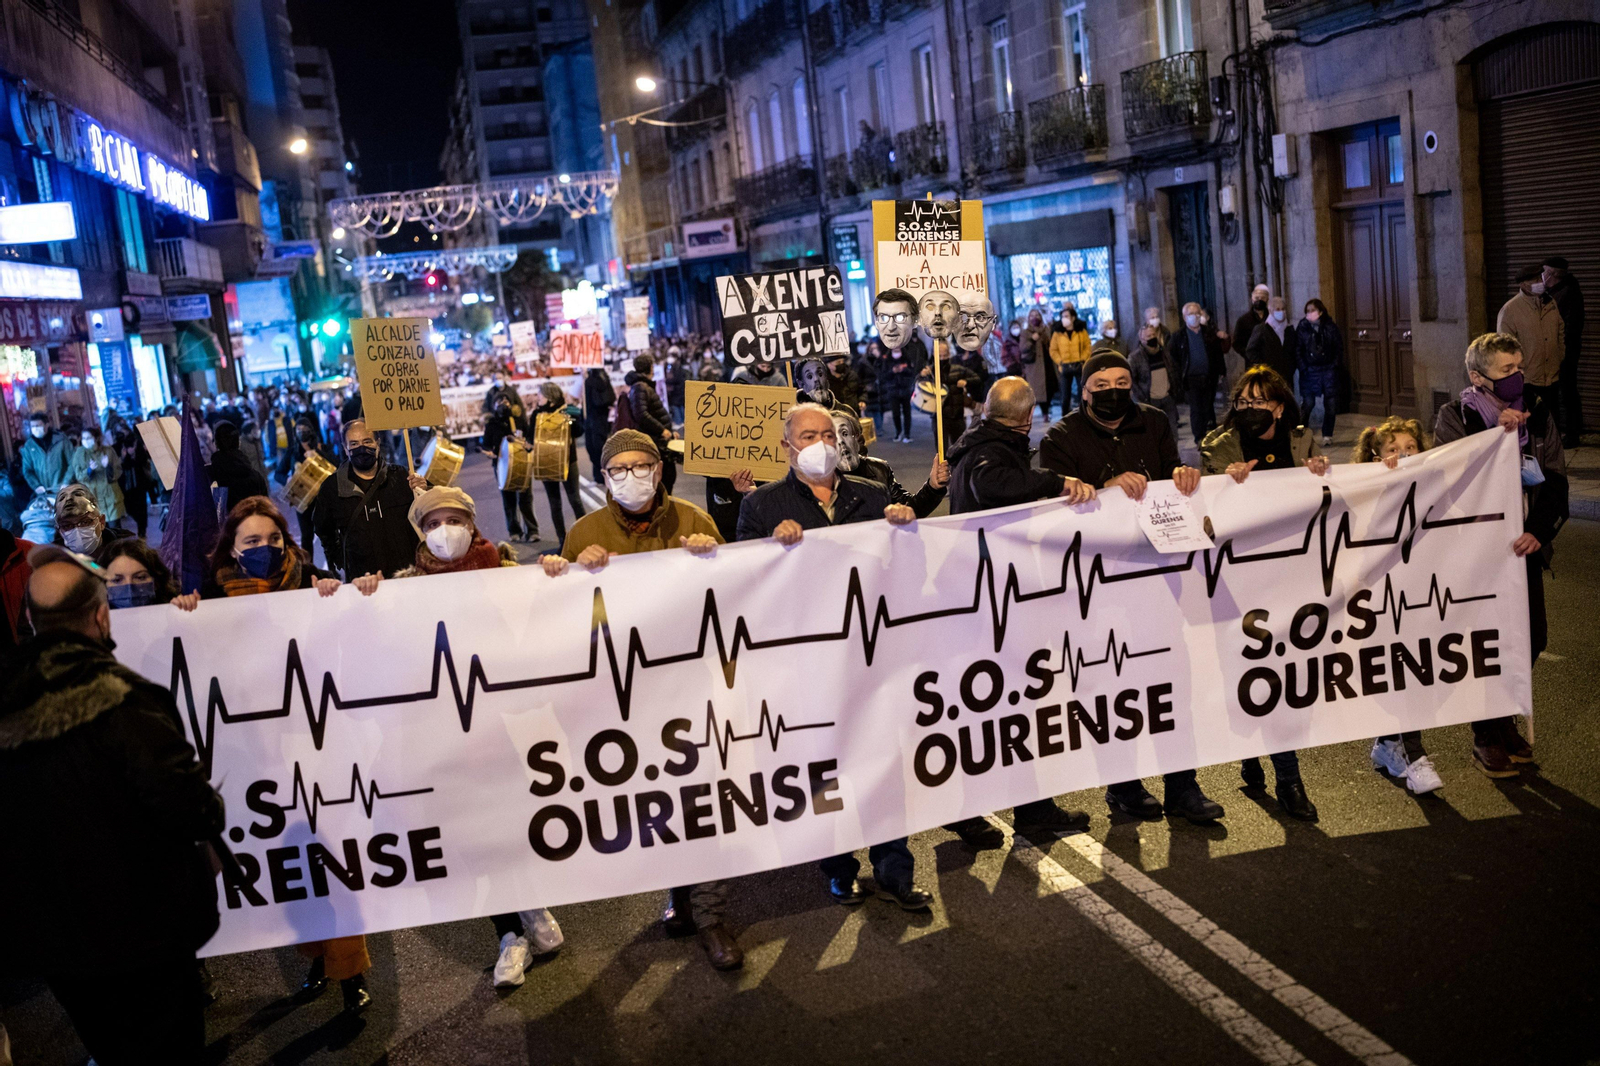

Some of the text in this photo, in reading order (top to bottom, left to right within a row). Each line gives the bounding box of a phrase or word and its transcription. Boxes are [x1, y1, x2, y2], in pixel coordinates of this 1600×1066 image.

[898, 221, 932, 231] S.O.S
[897, 230, 960, 241] OURENSE
[920, 259, 931, 274] A
[366, 324, 421, 342] ALCALDE
[367, 345, 425, 361] GONZALO
[381, 362, 419, 377] COBRAS
[372, 378, 431, 394] POR DARME
[384, 397, 394, 411] O
[398, 396, 425, 411] PALO
[691, 441, 786, 463] KULTURAL
[1151, 515, 1185, 526] OURENSE
[1241, 589, 1377, 660] S.O.S
[1237, 629, 1501, 717] OURENSE
[913, 648, 1054, 727] S.O.S
[913, 682, 1175, 787] OURENSE
[527, 718, 699, 797] S.O.S
[528, 758, 844, 861] OURENSE
[221, 826, 448, 909] RENSE
